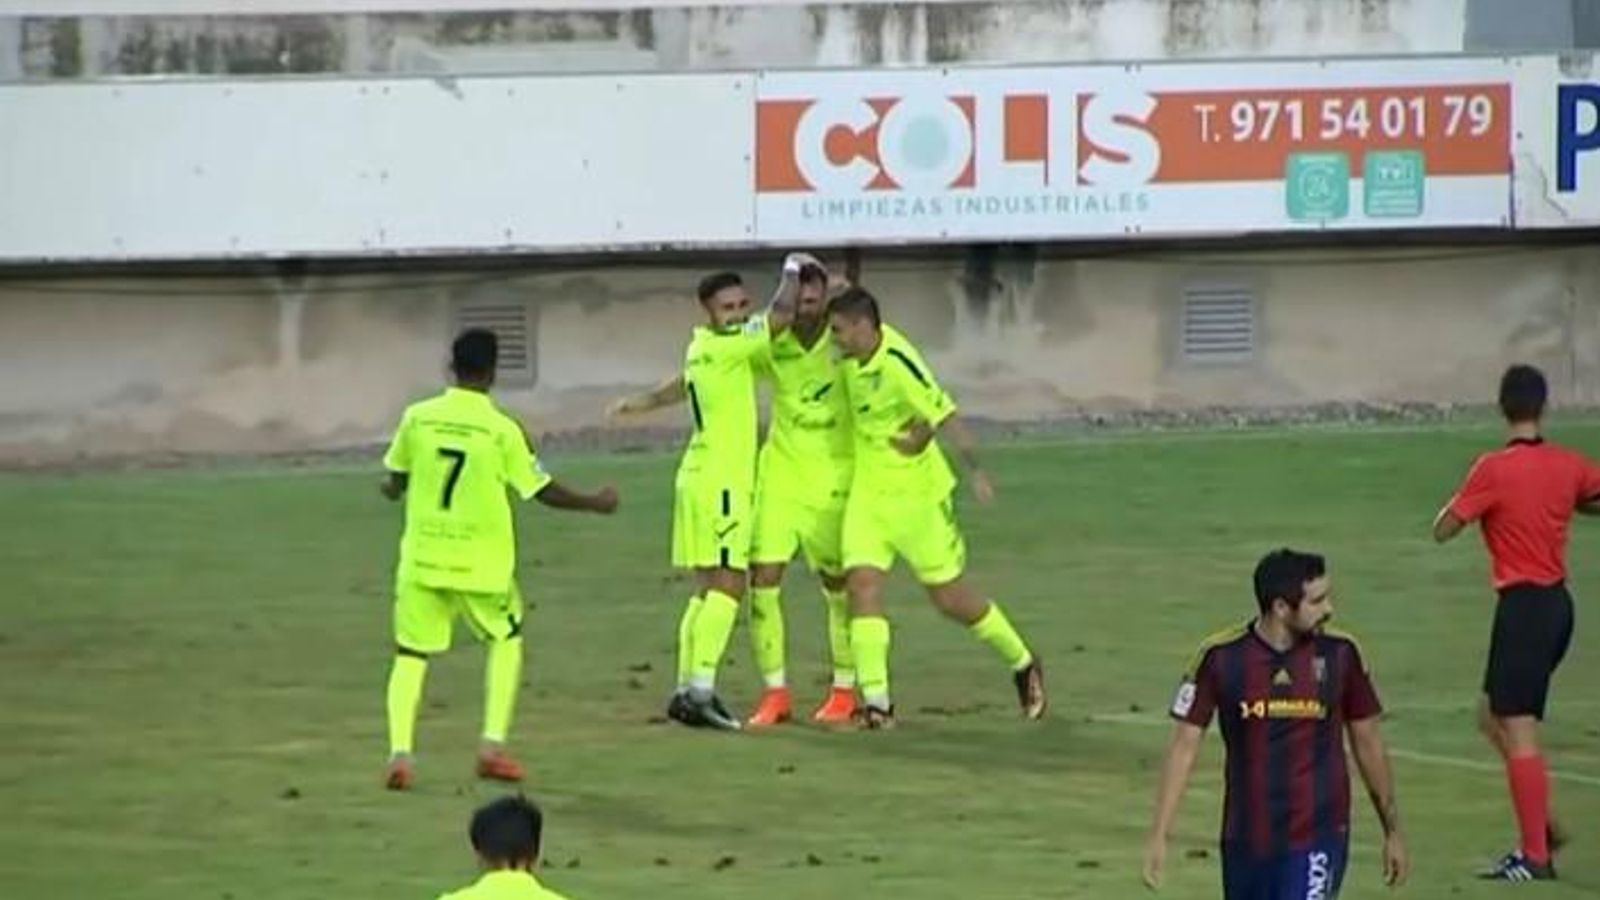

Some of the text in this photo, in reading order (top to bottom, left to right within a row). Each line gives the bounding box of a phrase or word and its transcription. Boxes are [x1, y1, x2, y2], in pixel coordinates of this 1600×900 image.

[794, 92, 1162, 192] COLIS
[1194, 94, 1493, 143] T. 971 54 01 79
[801, 193, 1150, 219] LIMPIEZAS INDUSTRIALES
[437, 447, 466, 510] 7
